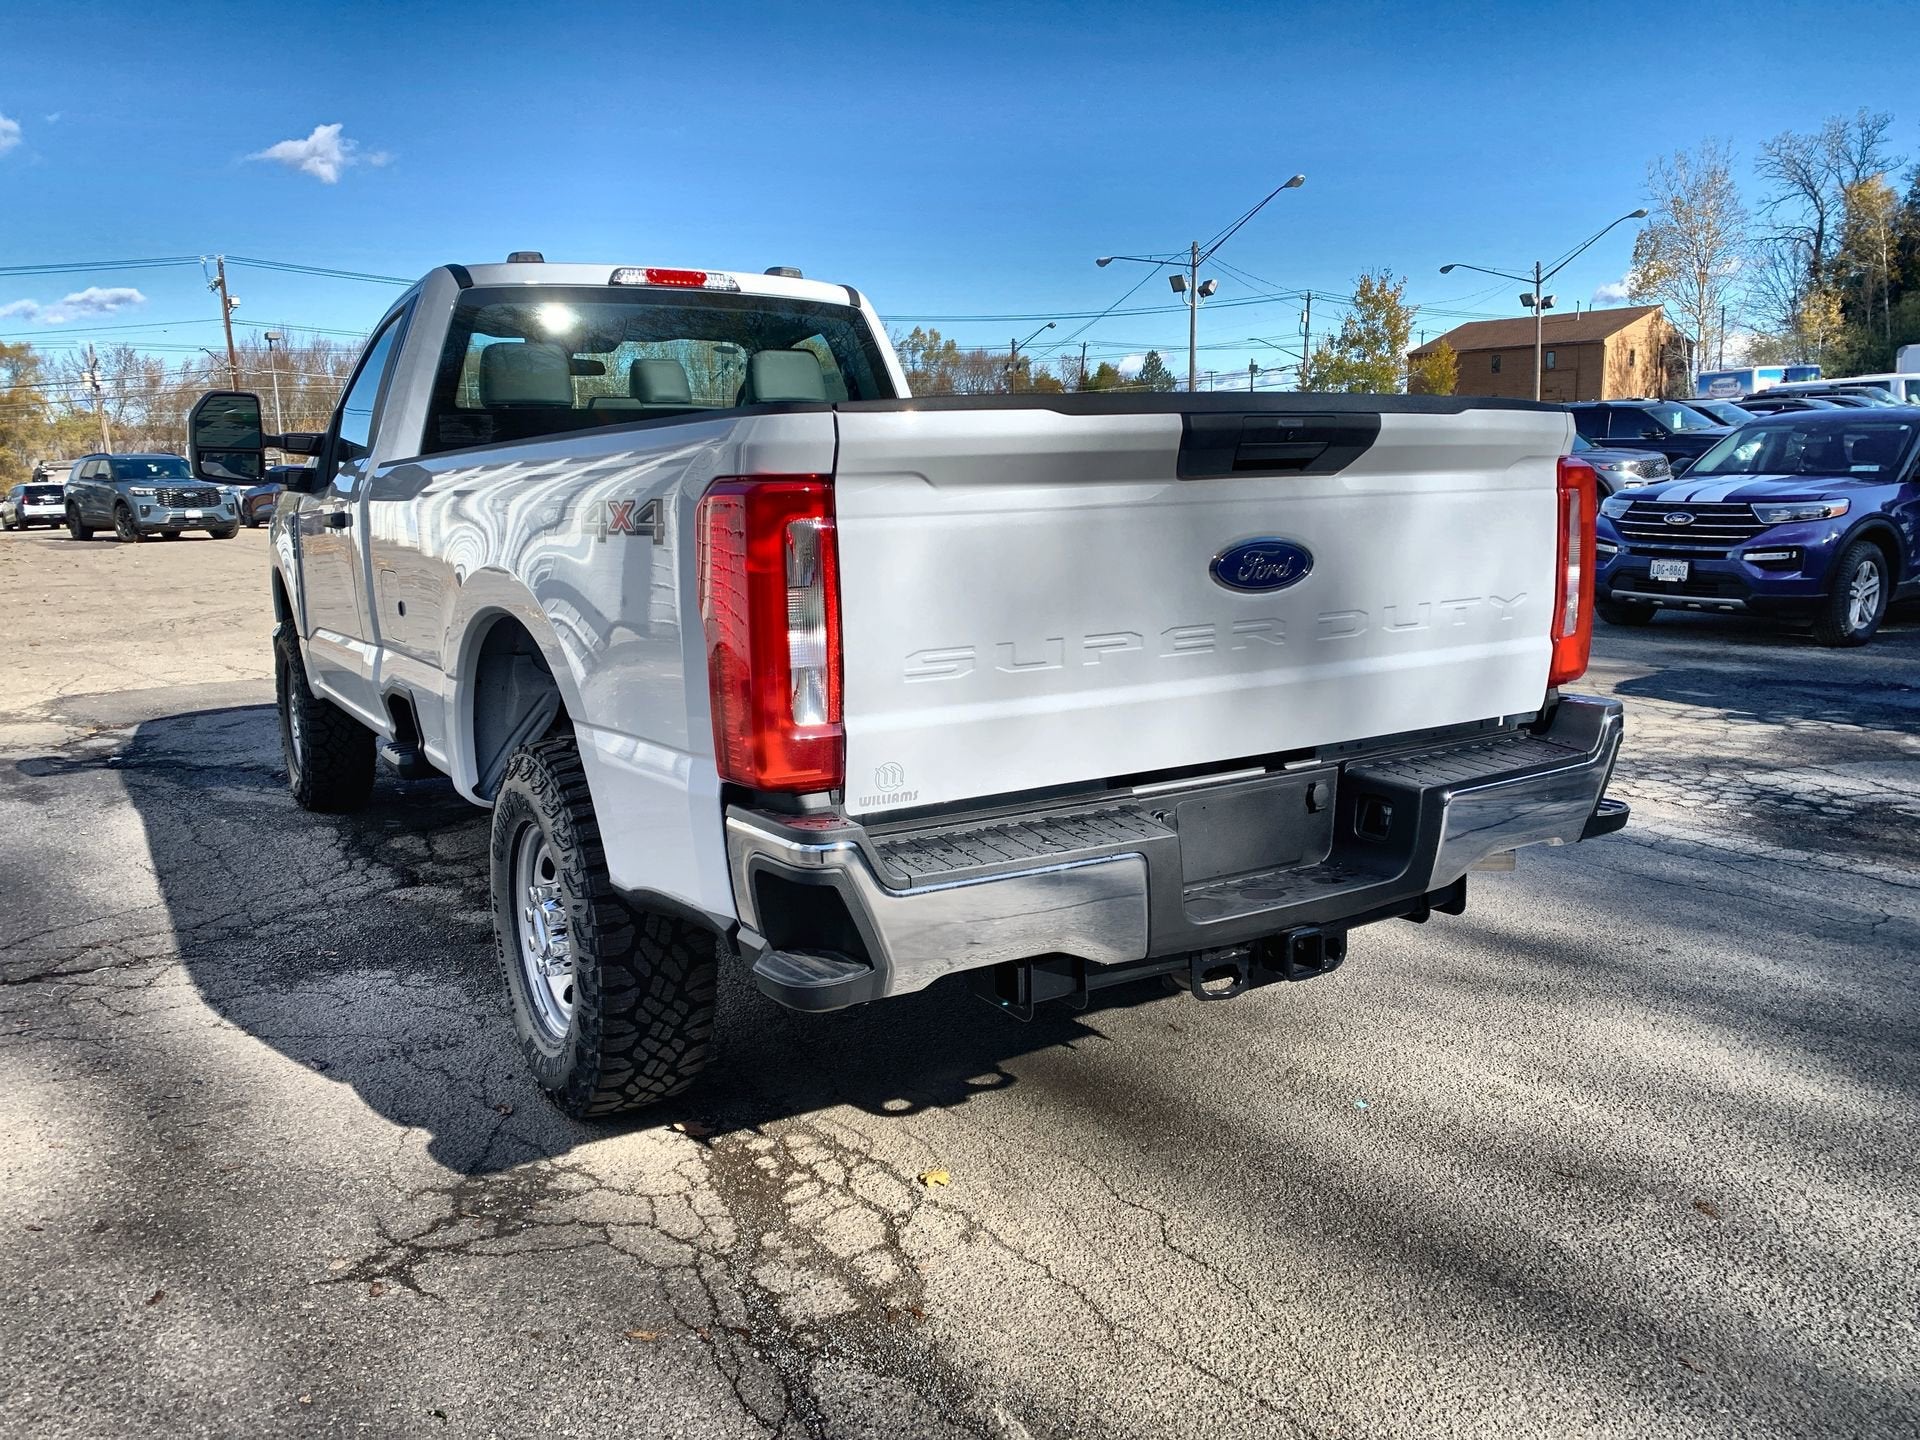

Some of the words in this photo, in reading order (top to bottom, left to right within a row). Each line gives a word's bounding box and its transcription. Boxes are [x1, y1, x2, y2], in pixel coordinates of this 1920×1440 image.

[1238, 550, 1294, 580] Ford
[904, 617, 1287, 683] SUPER
[1317, 592, 1528, 641] DUTY
[858, 790, 919, 807] WILLIAMS
